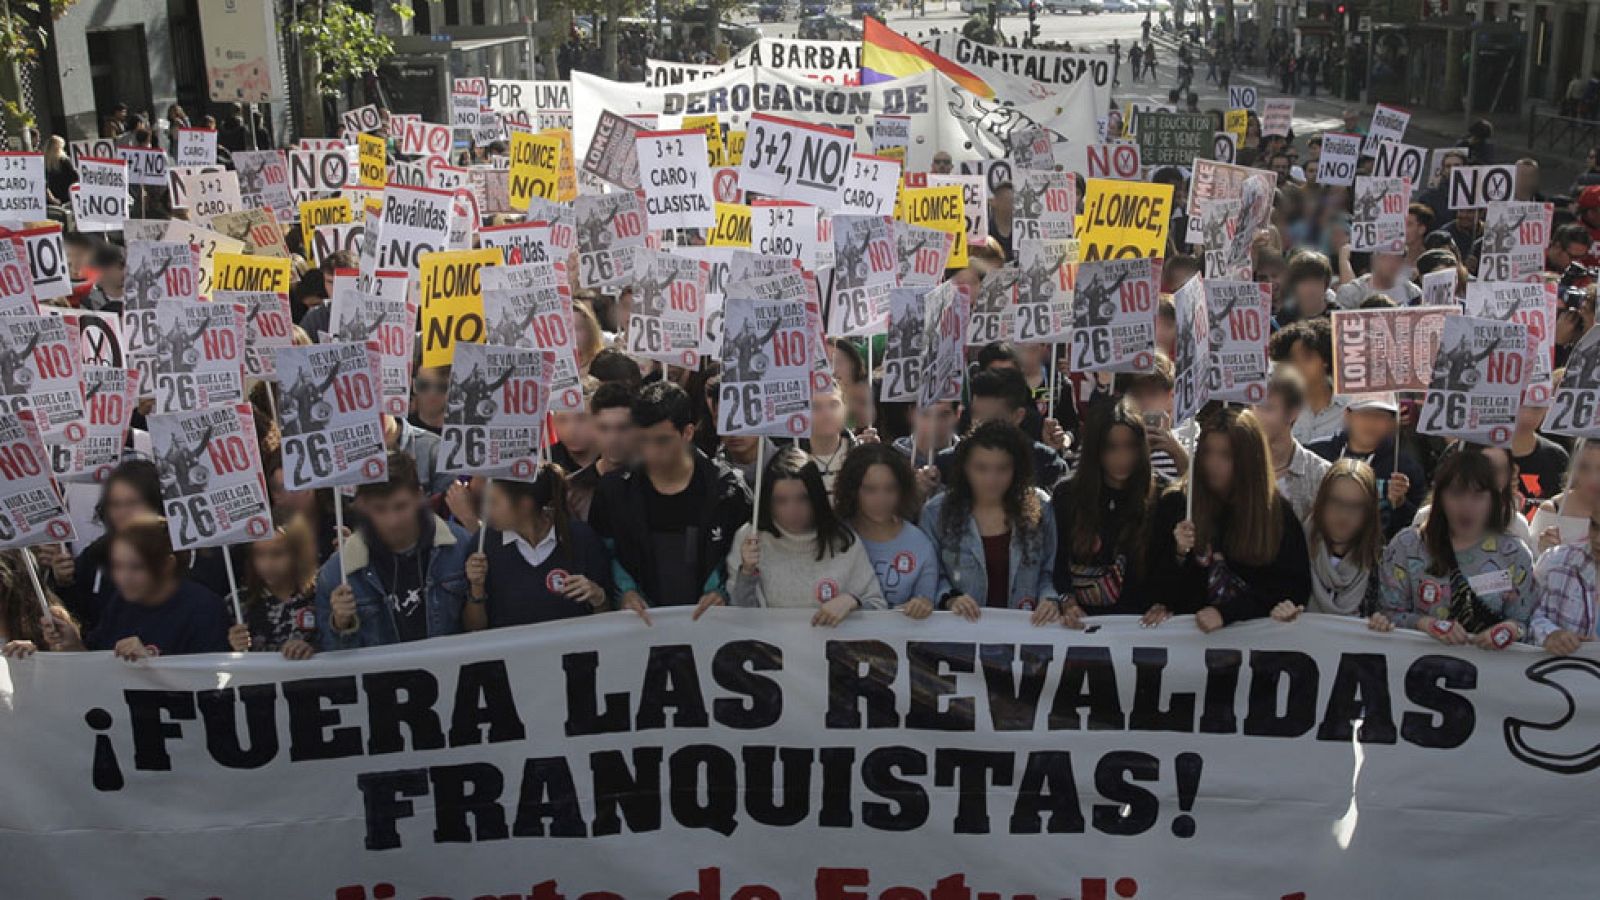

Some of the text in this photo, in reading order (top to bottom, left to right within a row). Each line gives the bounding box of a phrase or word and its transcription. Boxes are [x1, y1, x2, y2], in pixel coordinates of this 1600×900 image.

[772, 43, 861, 70] BARBA
[956, 39, 1108, 87] CAPITALISMO
[489, 84, 521, 108] POR
[535, 85, 571, 108] UNA
[883, 85, 928, 115] DE
[1230, 87, 1255, 108] NO
[345, 107, 379, 133] NO
[404, 123, 450, 154] NO
[293, 153, 348, 188] NO
[749, 125, 793, 186] 3+2,
[796, 135, 851, 188] NO!
[1086, 146, 1138, 178] NO
[1374, 144, 1421, 185] NO
[263, 163, 285, 186] NO
[651, 167, 688, 187] CARO
[1454, 168, 1513, 207] NO
[82, 195, 127, 218] ¡NO!
[195, 201, 225, 218] CARO
[843, 187, 874, 208] CARO
[1044, 188, 1068, 213] NO
[385, 196, 449, 236] Reválidas,
[613, 212, 641, 239] NO
[1085, 192, 1164, 239] ¡LOMCE,
[250, 223, 279, 248] NO
[549, 226, 571, 249] NO
[760, 237, 792, 256] CARO
[1353, 224, 1376, 249] 26
[1519, 222, 1543, 246] NO
[582, 249, 614, 286] 26
[867, 240, 894, 274] NO
[914, 249, 941, 277] NO
[1483, 256, 1510, 282] 26
[163, 267, 193, 298] NO
[670, 280, 698, 313] NO
[1119, 280, 1151, 313] NO
[255, 311, 287, 338] NO
[838, 288, 868, 334] 26
[1018, 304, 1049, 340] 26
[1229, 308, 1261, 341] NO
[126, 312, 158, 353] 26
[201, 328, 237, 362] NO
[378, 324, 405, 357] NO
[532, 313, 567, 349] NO
[631, 316, 662, 353] 26
[972, 315, 1000, 344] 26
[32, 343, 73, 380] NO
[772, 330, 807, 369] NO
[1075, 328, 1112, 369] 26
[1343, 313, 1367, 389] LOMCE
[886, 356, 920, 399] 26
[1487, 351, 1523, 385] NO
[89, 394, 124, 426] NO
[158, 374, 196, 413] 26
[332, 373, 373, 414] NO
[503, 379, 538, 415] NO
[722, 382, 763, 432] 26
[1426, 391, 1467, 431] 26
[1550, 391, 1595, 431] 26
[206, 435, 250, 476] NO
[286, 432, 333, 488] 26
[444, 427, 486, 470] 26
[168, 495, 217, 547] 26
[84, 639, 1478, 792] ¡FUERA LAS REVALIDAS
[357, 743, 1204, 851] FRANQUISTAS!
